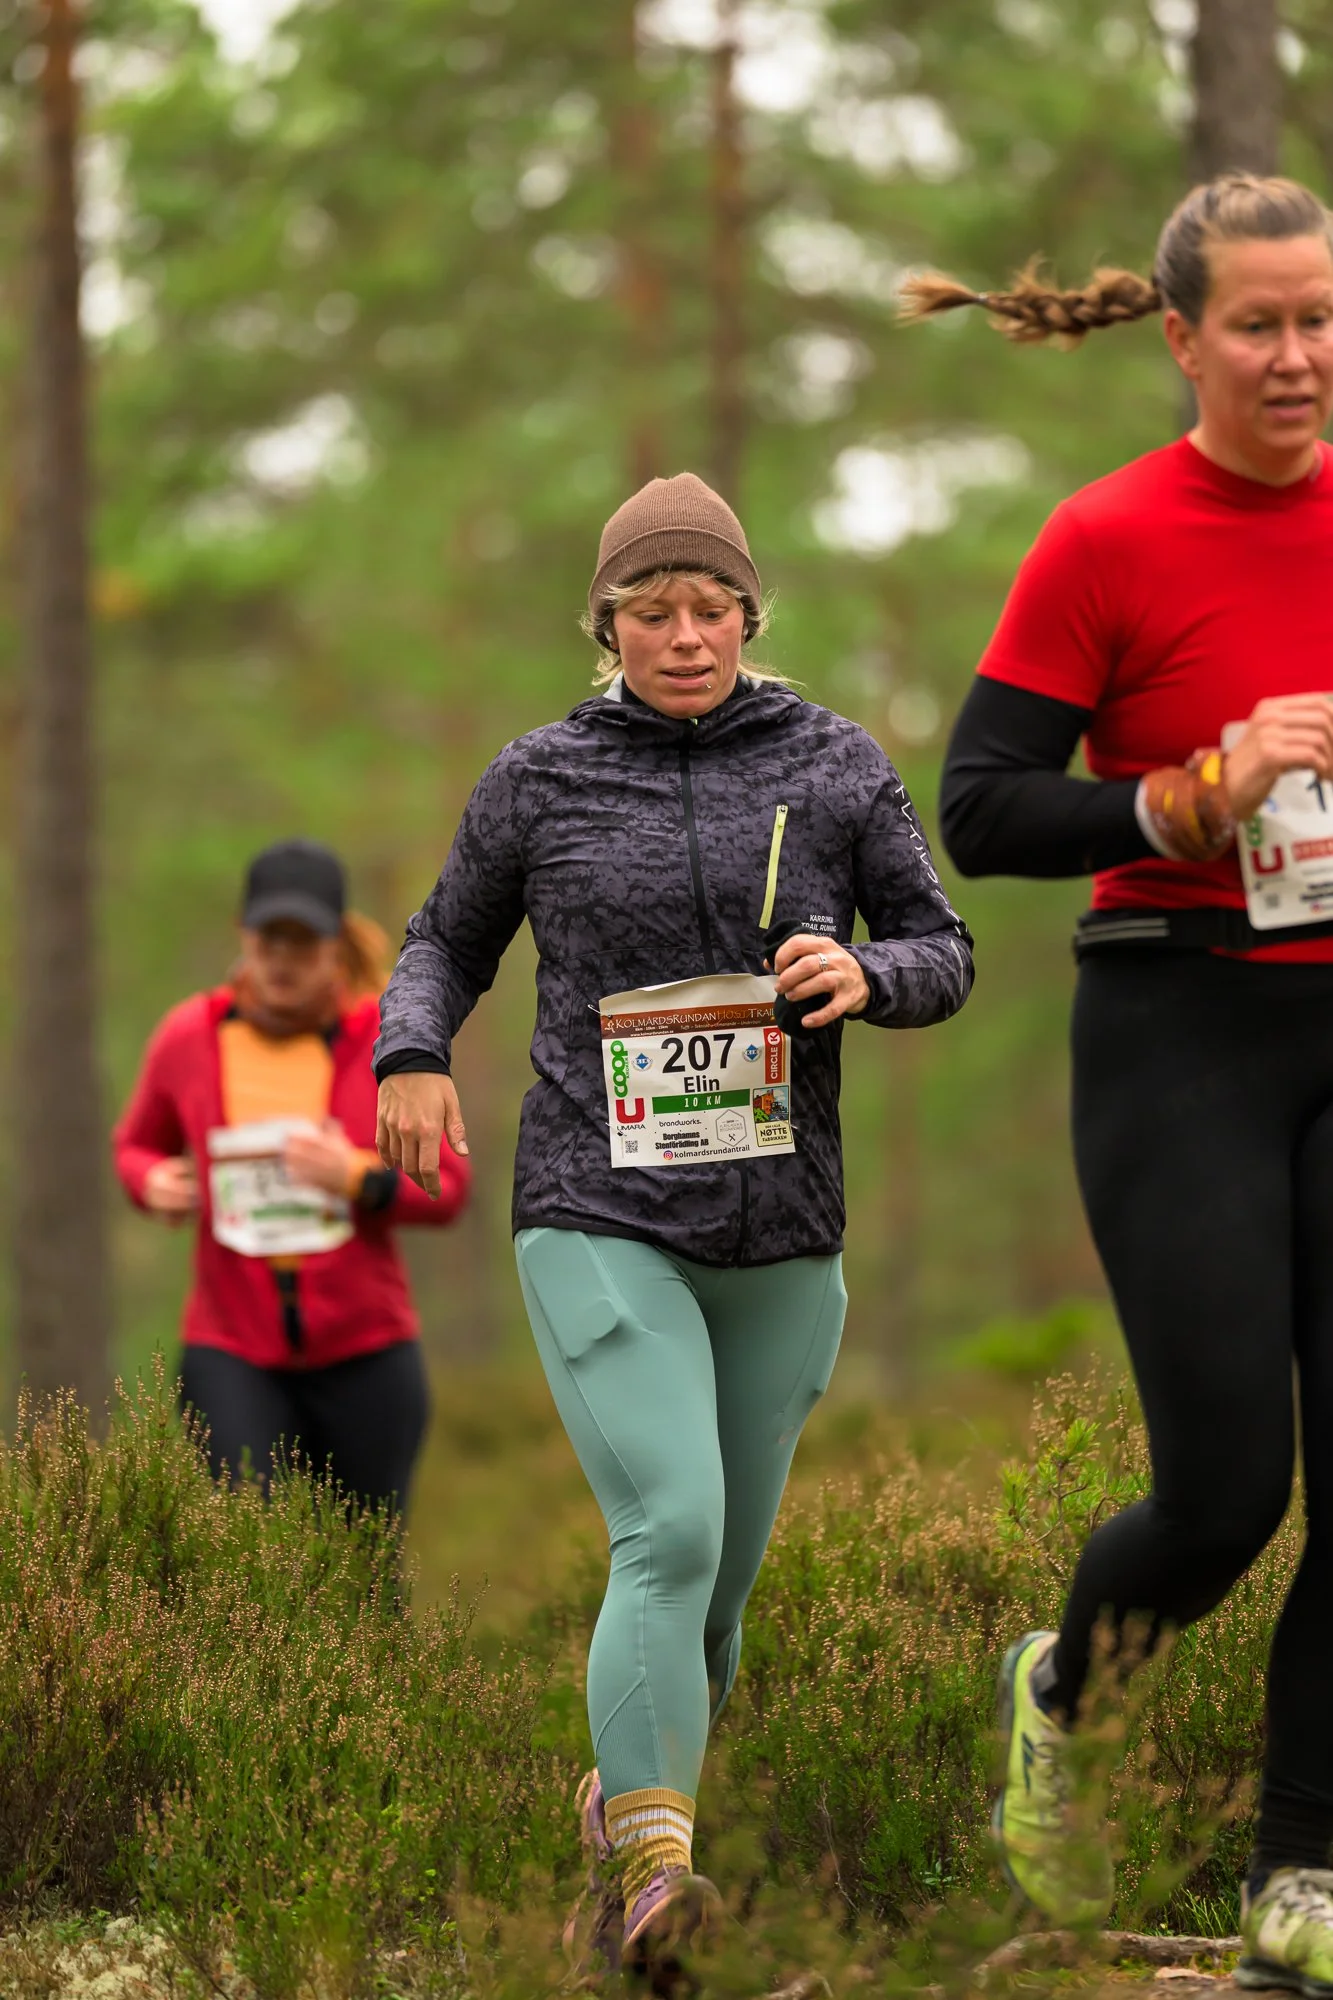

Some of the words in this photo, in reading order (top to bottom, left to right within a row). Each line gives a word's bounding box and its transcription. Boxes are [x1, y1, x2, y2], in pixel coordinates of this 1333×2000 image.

[615, 1012, 716, 1030] KOLMÅRDSRUNDAN
[661, 1033, 736, 1073] 207
[610, 1040, 628, 1098] coop
[770, 1047, 778, 1079] CIRCLE
[684, 1075, 720, 1093] Elin
[684, 1097, 698, 1107] 10
[706, 1095, 721, 1105] KM
[760, 1127, 788, 1137] NØTTE
[674, 1145, 750, 1158] kolmardsrundantrail
